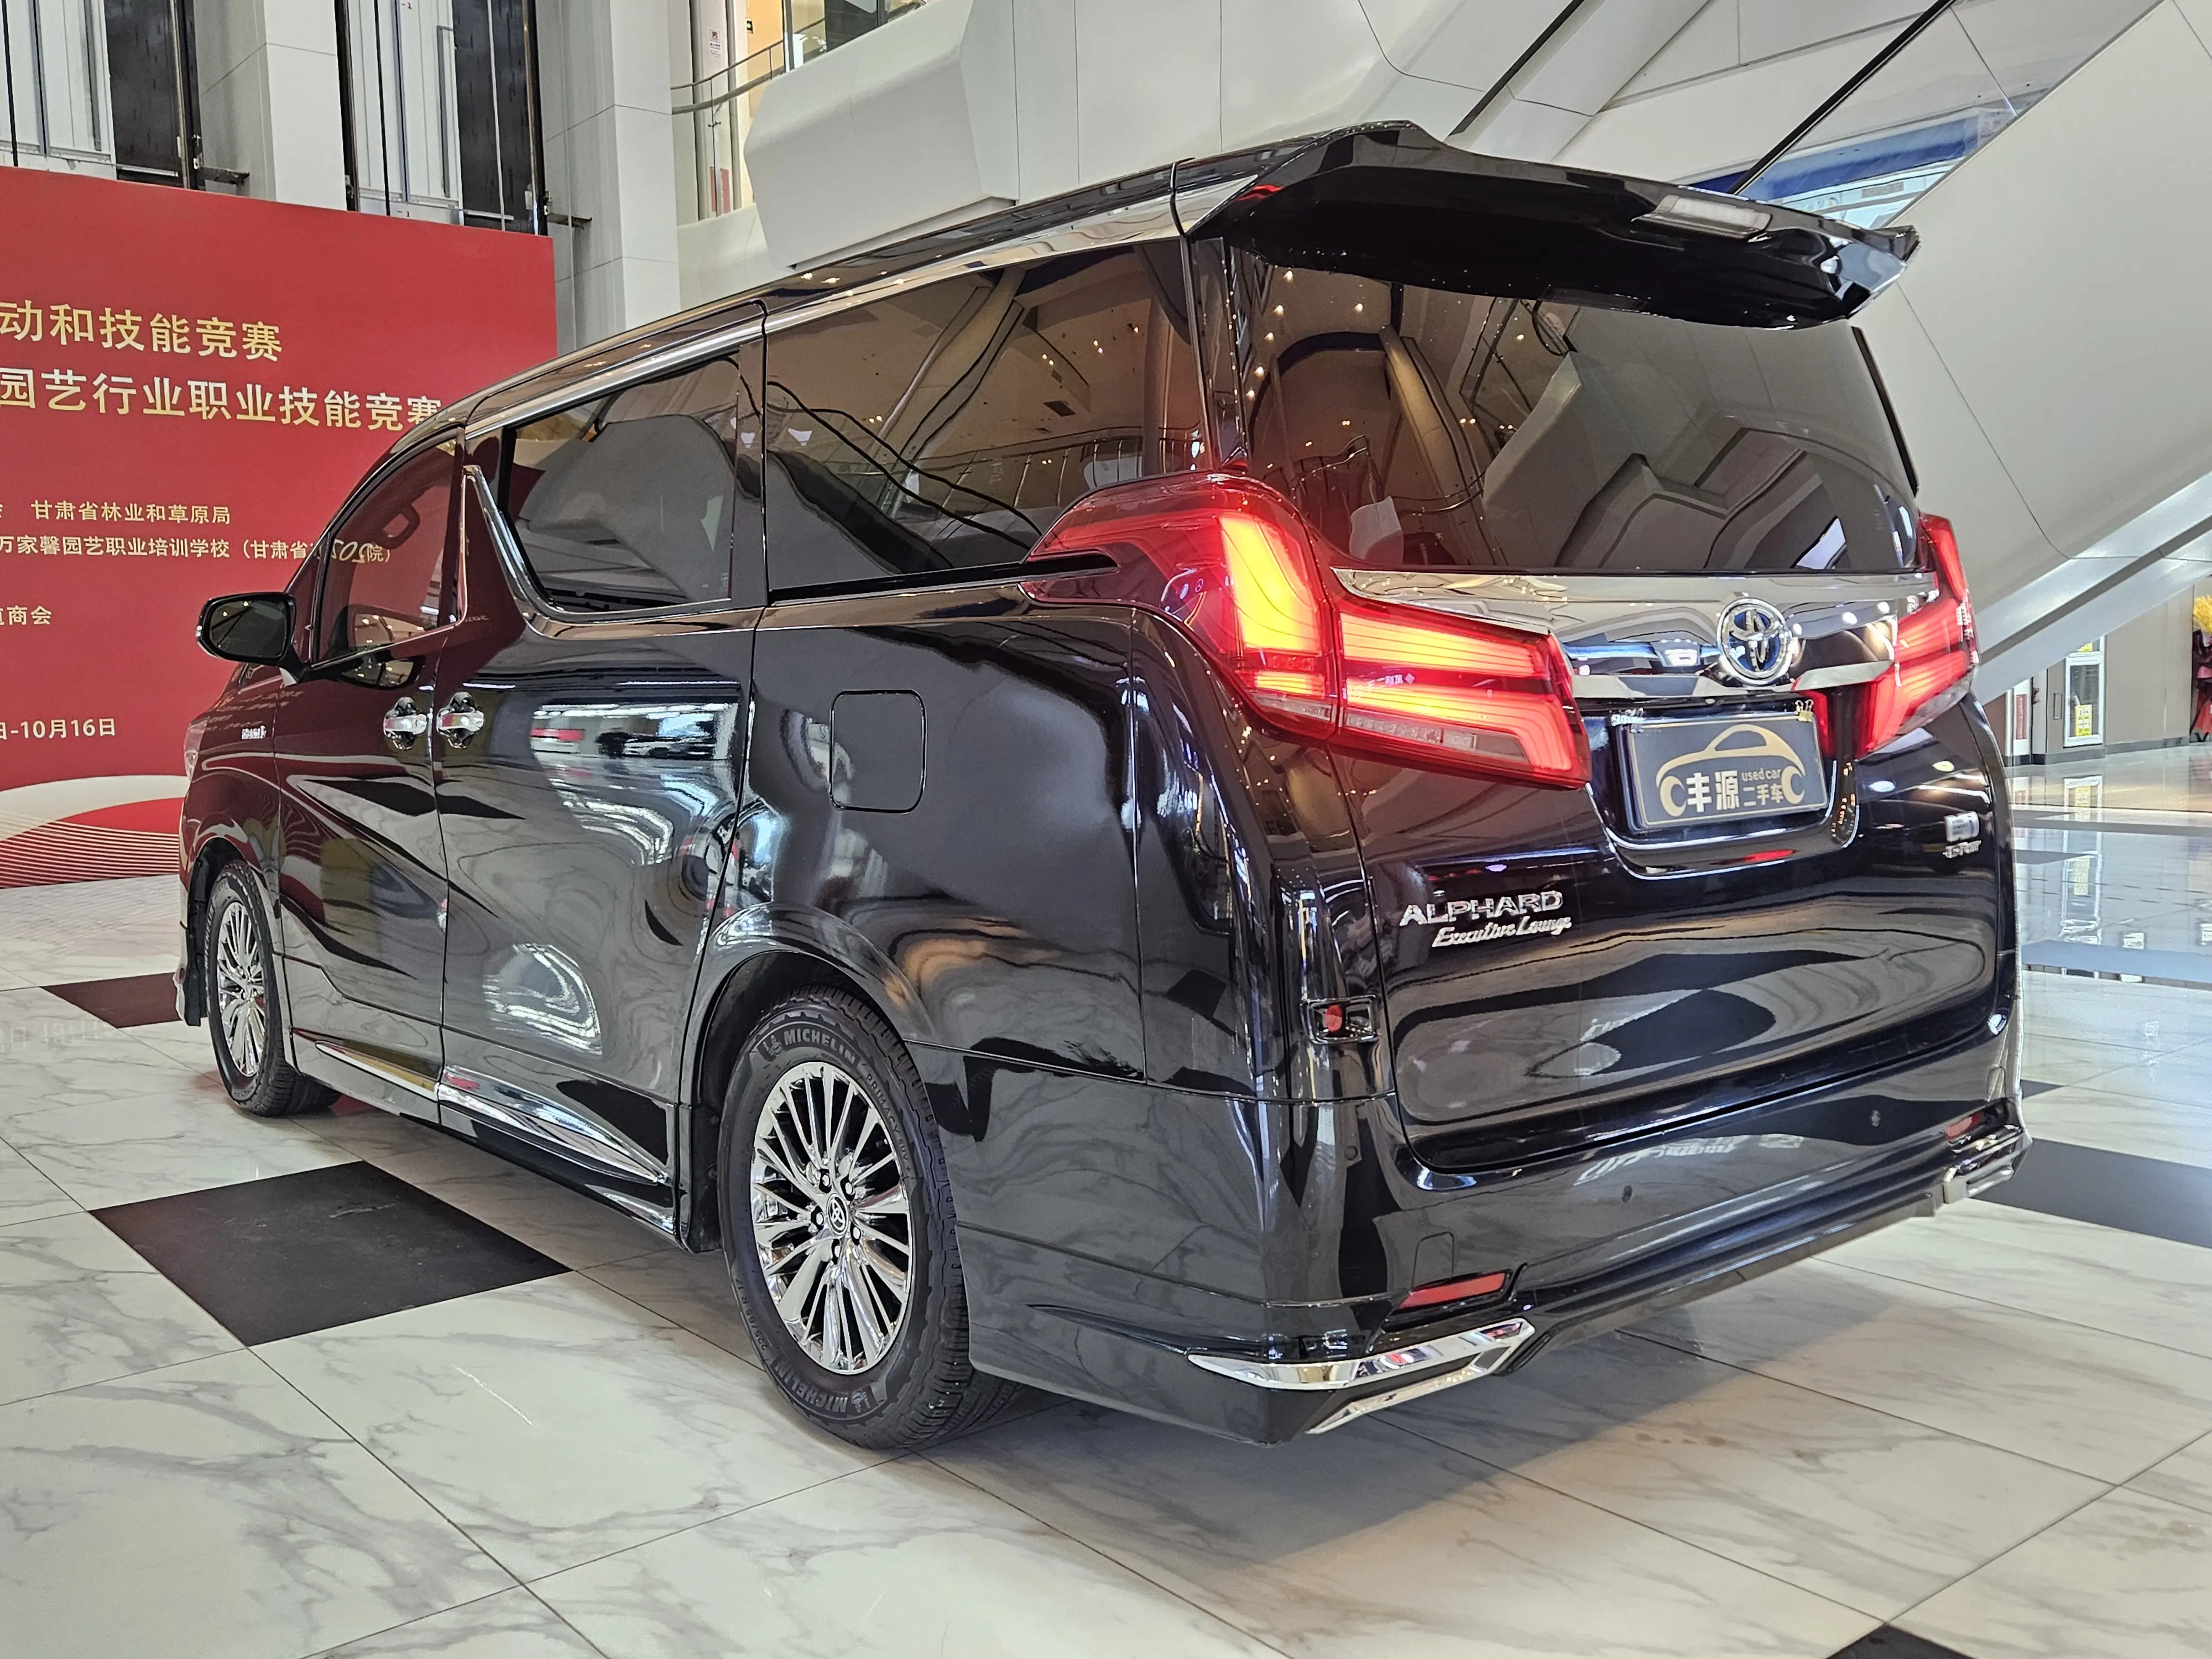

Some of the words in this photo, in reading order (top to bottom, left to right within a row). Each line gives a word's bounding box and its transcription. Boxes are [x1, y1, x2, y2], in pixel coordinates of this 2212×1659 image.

[0, 300, 282, 362] 动和技能竞赛
[31, 500, 231, 524] 甘肃省林业和草原局
[1686, 770, 1740, 813] 丰源
[1741, 767, 1765, 782] used
[1766, 768, 1781, 780] car
[1743, 784, 1784, 807] 二手车
[1399, 890, 1564, 927] ALPHARD
[1432, 922, 1517, 948] Executive
[1515, 916, 1572, 936] Lounge
[783, 1028, 856, 1065] MICHELIN
[866, 1072, 900, 1133] PRIMACY
[774, 1360, 848, 1413] MICHELIN
